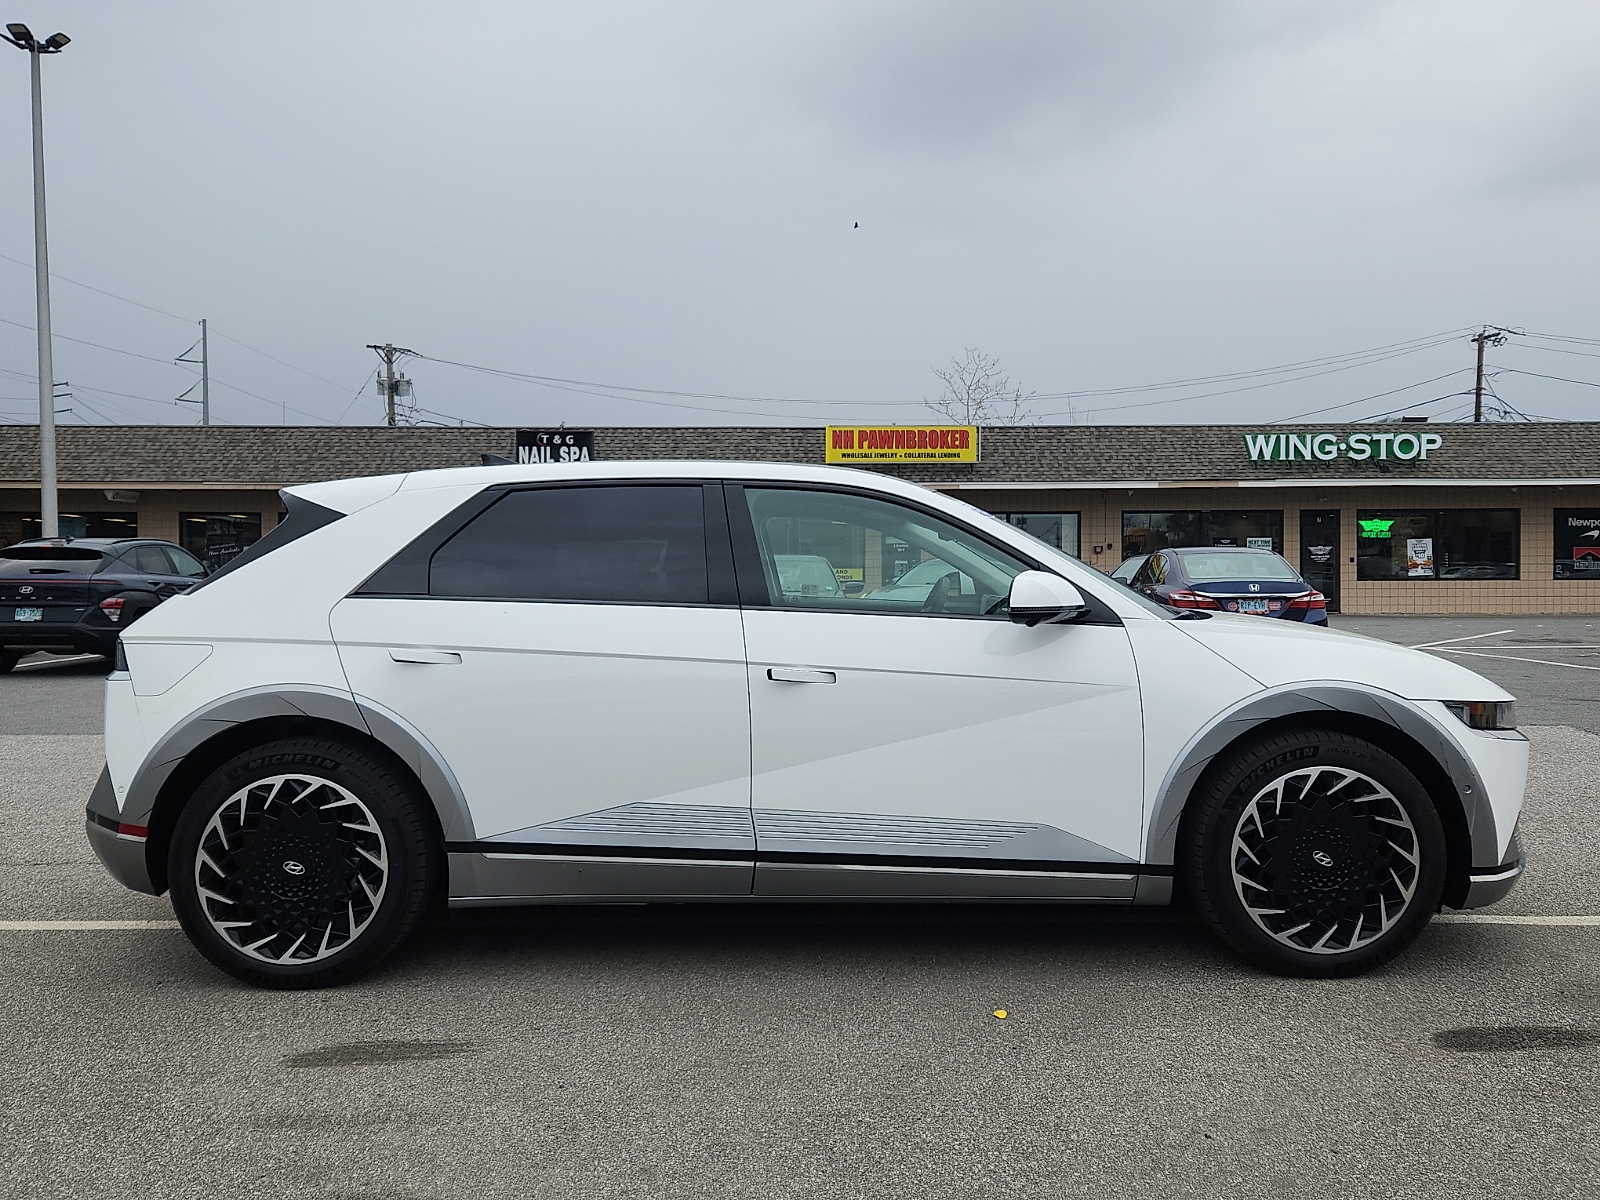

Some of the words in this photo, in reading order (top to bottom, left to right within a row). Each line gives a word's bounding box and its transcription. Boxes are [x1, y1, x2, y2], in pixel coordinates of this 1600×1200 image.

[540, 435, 549, 444] T
[553, 434, 562, 444] &
[565, 435, 574, 444] G
[831, 429, 854, 450] NH
[857, 429, 970, 450] PAWNBROKER
[518, 446, 555, 464] NAIL
[559, 446, 590, 463] SPA
[249, 753, 337, 769] MICHELIN
[1239, 747, 1315, 792] MICHELIN
